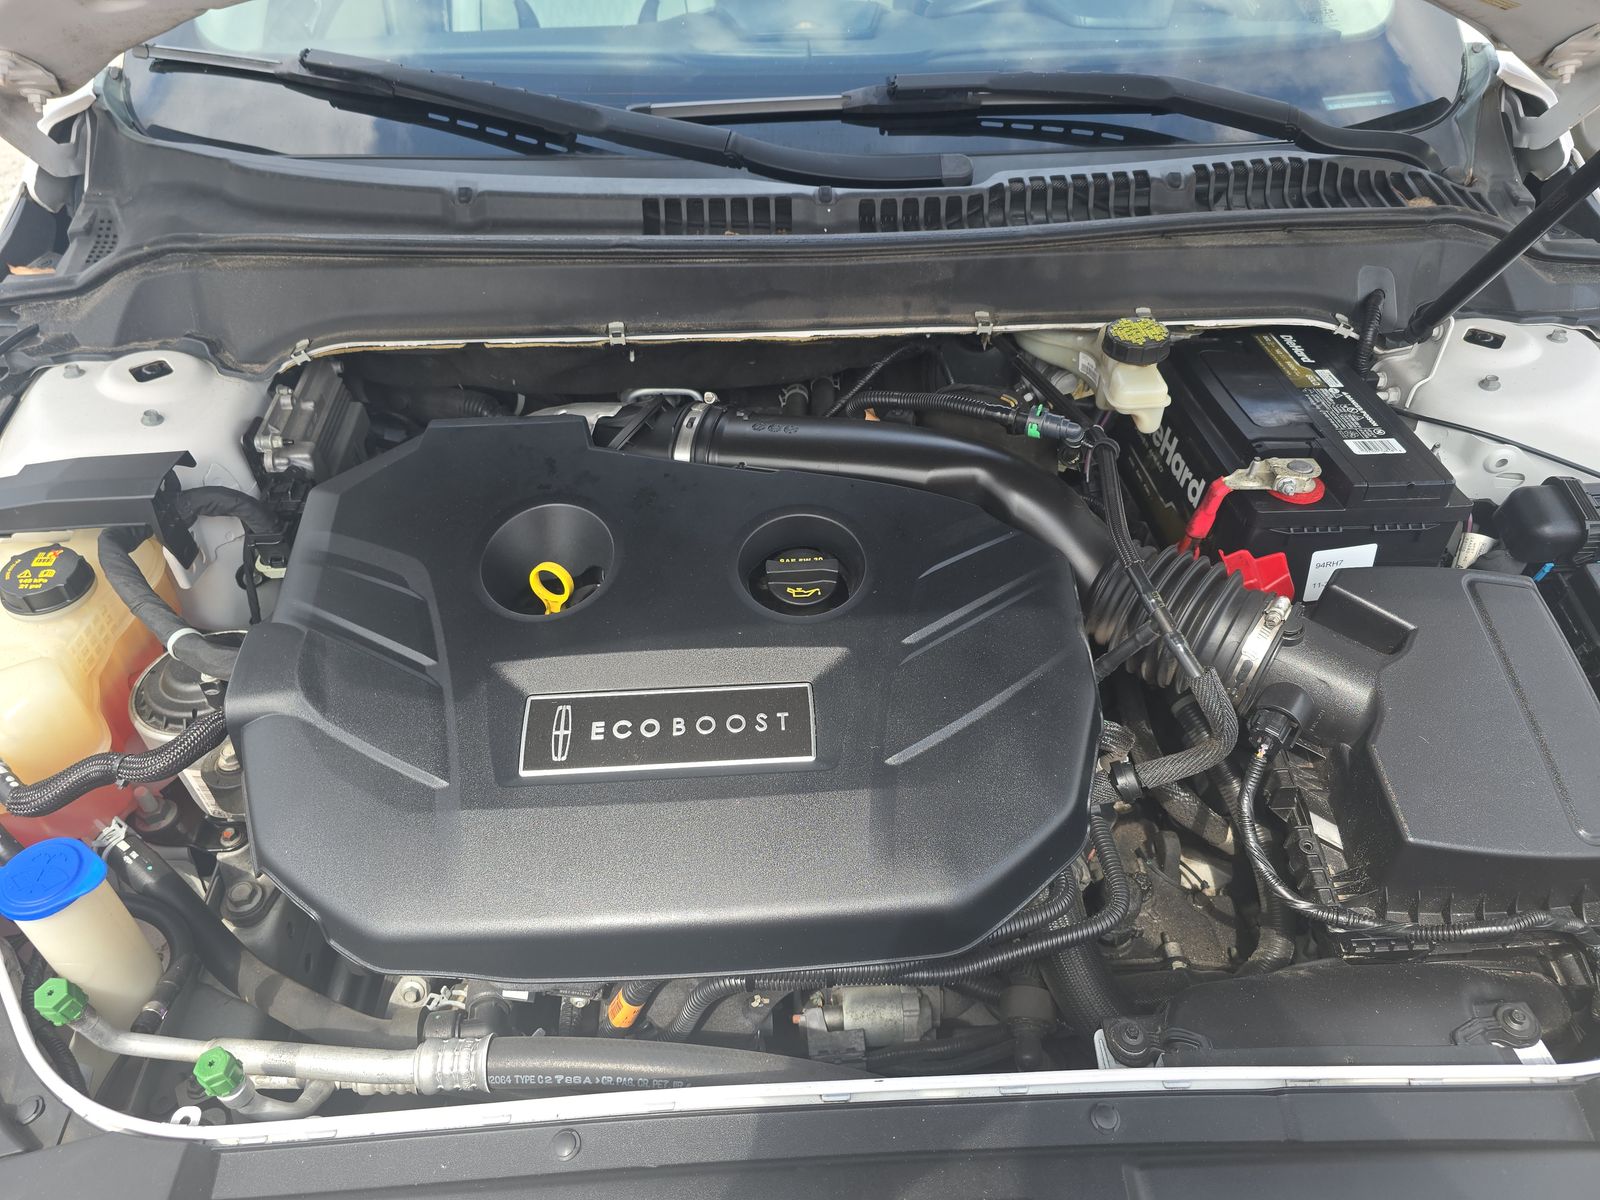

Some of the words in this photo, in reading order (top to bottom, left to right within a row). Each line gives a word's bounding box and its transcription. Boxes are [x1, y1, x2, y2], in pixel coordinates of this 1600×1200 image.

[1280, 334, 1315, 363] DieHard
[1152, 425, 1206, 509] eHard
[1315, 559, 1344, 569] 94RH7
[1312, 581, 1327, 589] 11-
[590, 711, 789, 741] ECOBOOST
[513, 1074, 536, 1085] TYPE
